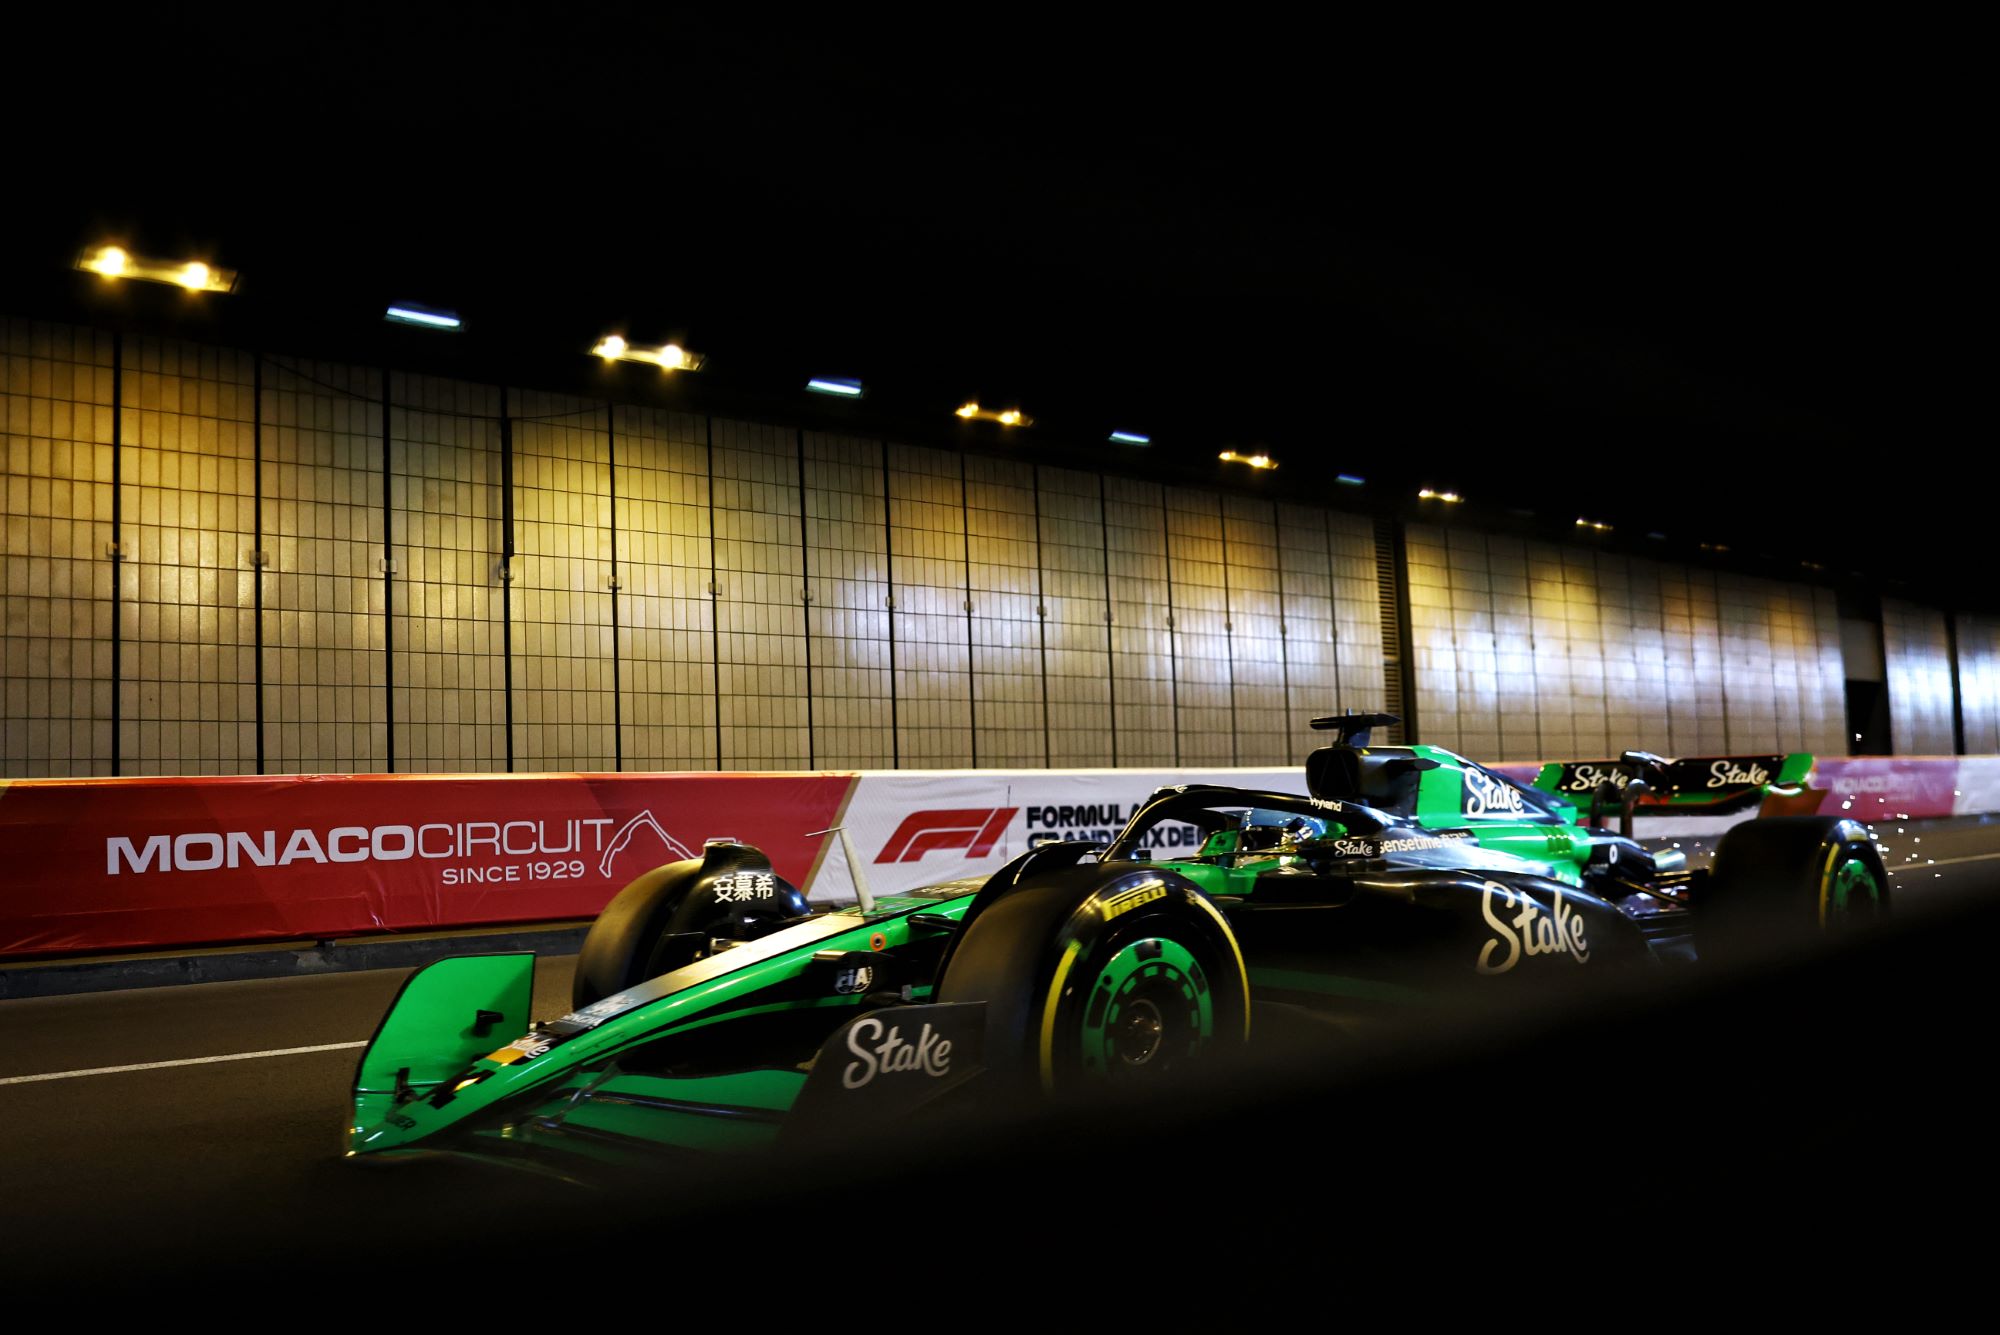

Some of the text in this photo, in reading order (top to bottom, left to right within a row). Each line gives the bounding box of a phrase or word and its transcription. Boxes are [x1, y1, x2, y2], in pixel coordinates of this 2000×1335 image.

[1706, 760, 1769, 788] Stake
[1465, 766, 1524, 816] Stake
[1334, 840, 1373, 857] Stake
[442, 860, 585, 885] SINCE 1929
[713, 873, 774, 904] 安慕希
[1476, 880, 1590, 975] Stake
[842, 1018, 952, 1089] Stake
